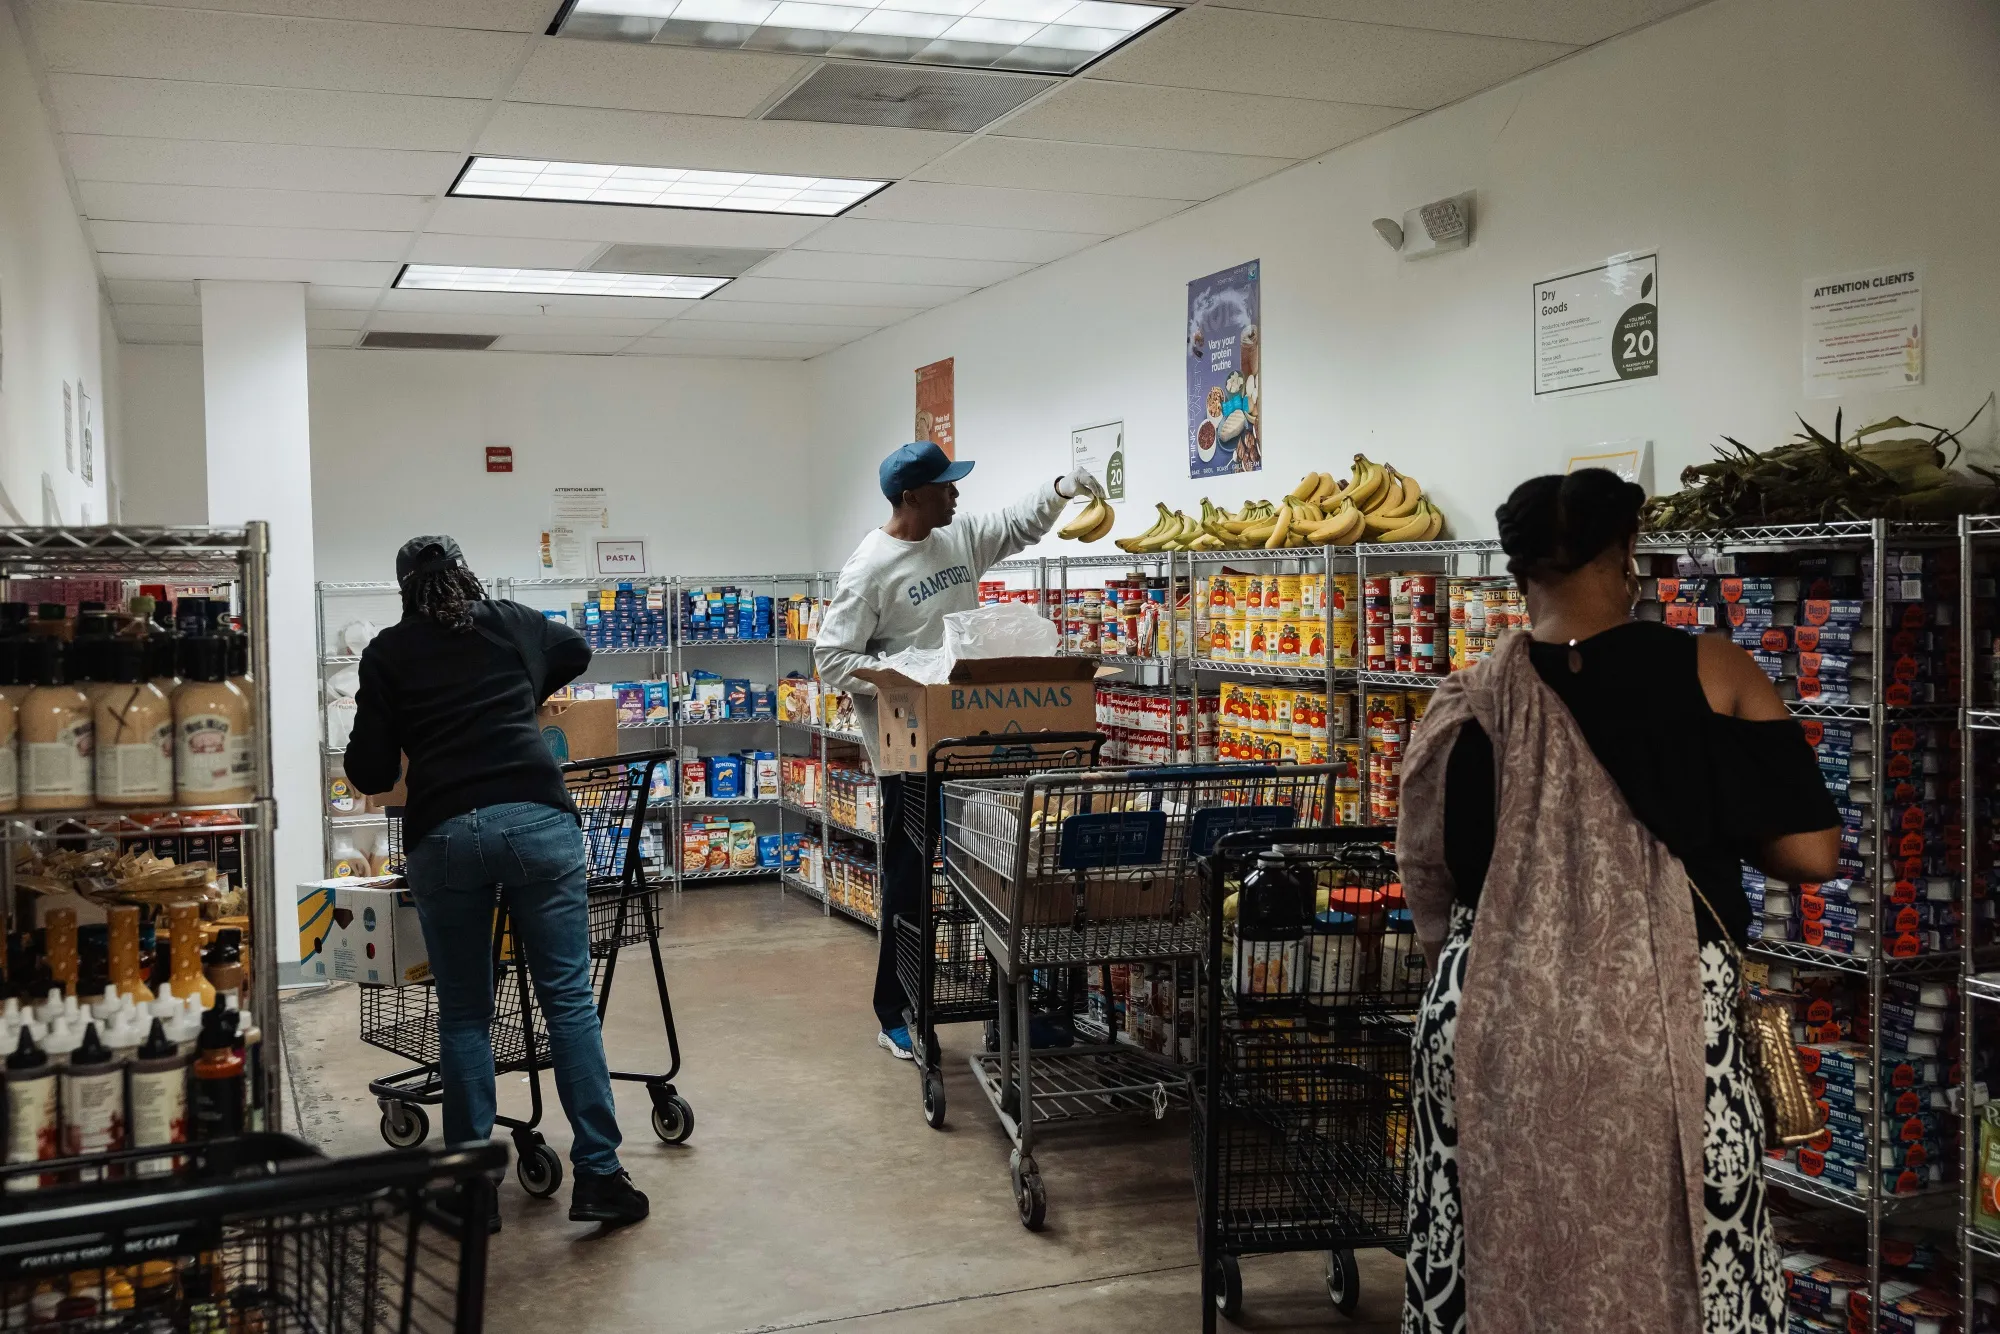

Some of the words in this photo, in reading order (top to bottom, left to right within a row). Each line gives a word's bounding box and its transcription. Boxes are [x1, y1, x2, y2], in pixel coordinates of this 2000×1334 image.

[1813, 280, 1870, 298] ATTENTION
[1872, 271, 1915, 287] CLIENTS
[1542, 291, 1556, 301] Dry
[1542, 302, 1568, 316] Goods
[1208, 339, 1221, 350] Vary
[1222, 336, 1235, 348] your
[1623, 329, 1654, 359] 20
[1211, 347, 1232, 362] protein
[1211, 360, 1232, 373] routine
[1110, 468, 1122, 486] 20
[908, 565, 971, 607] SAMFORD
[1661, 583, 1677, 592] Ben's
[1723, 583, 1740, 593] Ben's
[1746, 607, 1760, 615] STREET
[1808, 605, 1827, 614] Ben's
[1800, 631, 1816, 641] Ben's
[1770, 656, 1782, 664] FOOD
[1802, 656, 1818, 666] Ben's
[1801, 681, 1818, 691] Ben's
[951, 686, 1073, 711] BANANAS
[1824, 728, 1839, 736] STREET
[1818, 755, 1834, 763] STREET
[1834, 783, 1846, 791] FOOD
[1848, 809, 1861, 817] FOOD
[1845, 835, 1857, 843] FOOD
[1849, 859, 1863, 868] FOOD
[1803, 899, 1822, 910] Ben's
[1825, 903, 1842, 913] STREET
[1843, 906, 1857, 915] FOOD
[1805, 925, 1822, 936] Ben's
[1824, 930, 1841, 939] STREET
[1842, 933, 1853, 942] FOOD
[1888, 978, 1904, 988] STREET
[1905, 983, 1919, 992] FOOD
[1882, 1002, 1899, 1013] STREET
[1901, 1007, 1914, 1016] FOOD
[1895, 1032, 1907, 1041] FOOD
[1821, 1057, 1839, 1066] STREET
[1840, 1061, 1853, 1070] FOOD
[1826, 1083, 1841, 1092] STREET
[1842, 1087, 1853, 1096] FOOD
[1830, 1109, 1847, 1119] STREET
[1848, 1114, 1861, 1123] FOOD
[1832, 1137, 1849, 1147] STREET
[1851, 1142, 1865, 1151] FOOD
[1801, 1154, 1821, 1168] Ben's
[1825, 1162, 1842, 1173] STREET
[1843, 1168, 1855, 1177] FOOD
[1794, 1280, 1813, 1289] STREET
[1815, 1284, 1829, 1294] FOOD
[1900, 1316, 1913, 1326] FOOD
